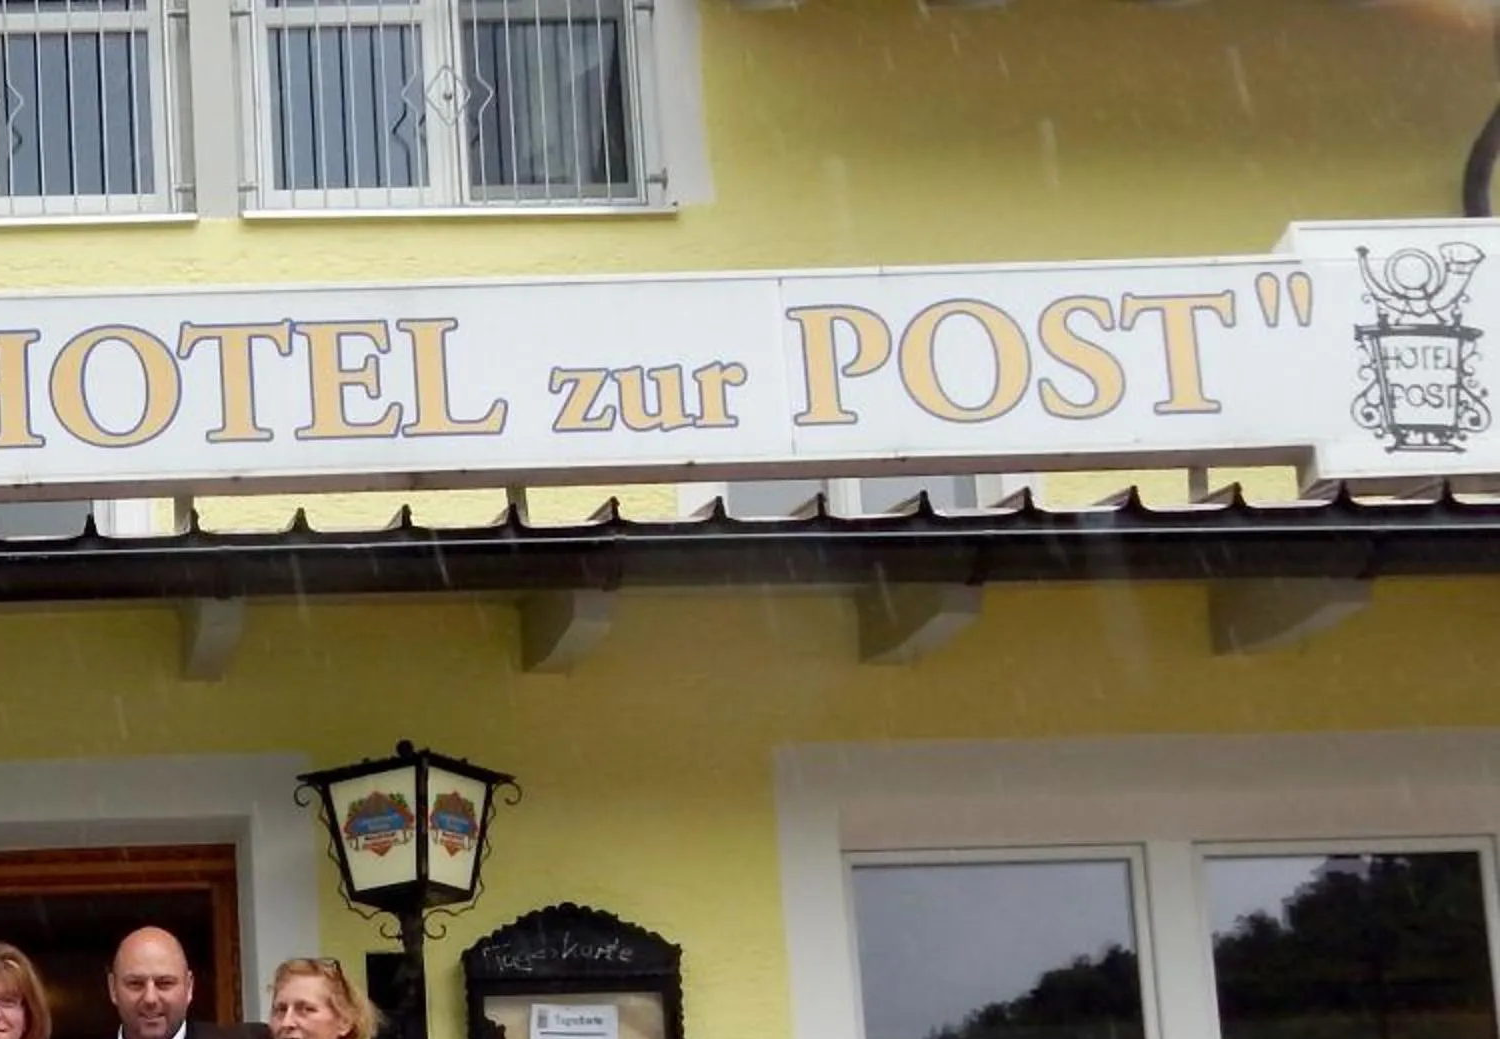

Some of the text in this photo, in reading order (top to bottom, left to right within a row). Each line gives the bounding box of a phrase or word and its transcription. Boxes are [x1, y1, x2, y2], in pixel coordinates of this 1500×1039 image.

[1382, 345, 1457, 370] HOTEL
[548, 360, 748, 432] zur
[1389, 383, 1457, 409] POST
